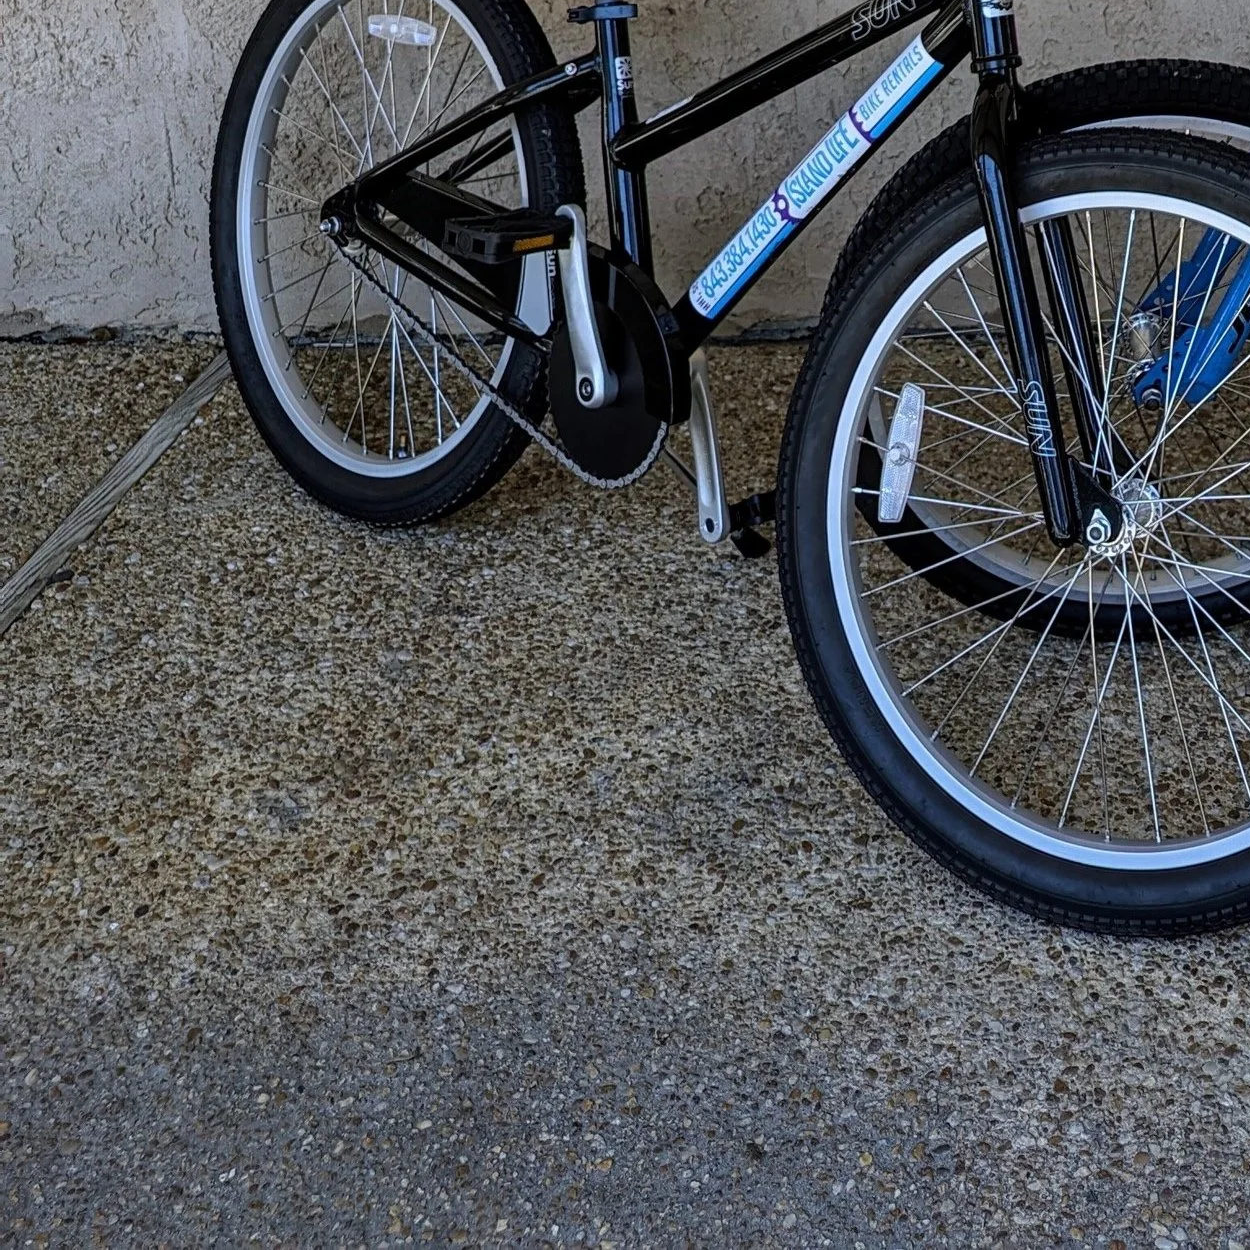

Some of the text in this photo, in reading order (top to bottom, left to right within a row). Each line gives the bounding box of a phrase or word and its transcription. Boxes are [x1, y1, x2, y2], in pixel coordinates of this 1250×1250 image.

[858, 46, 924, 121] BIKE RENTALS
[784, 120, 861, 209] ISLAND LIFE
[701, 205, 778, 299] 843.384.1430
[1016, 377, 1057, 457] SUN
